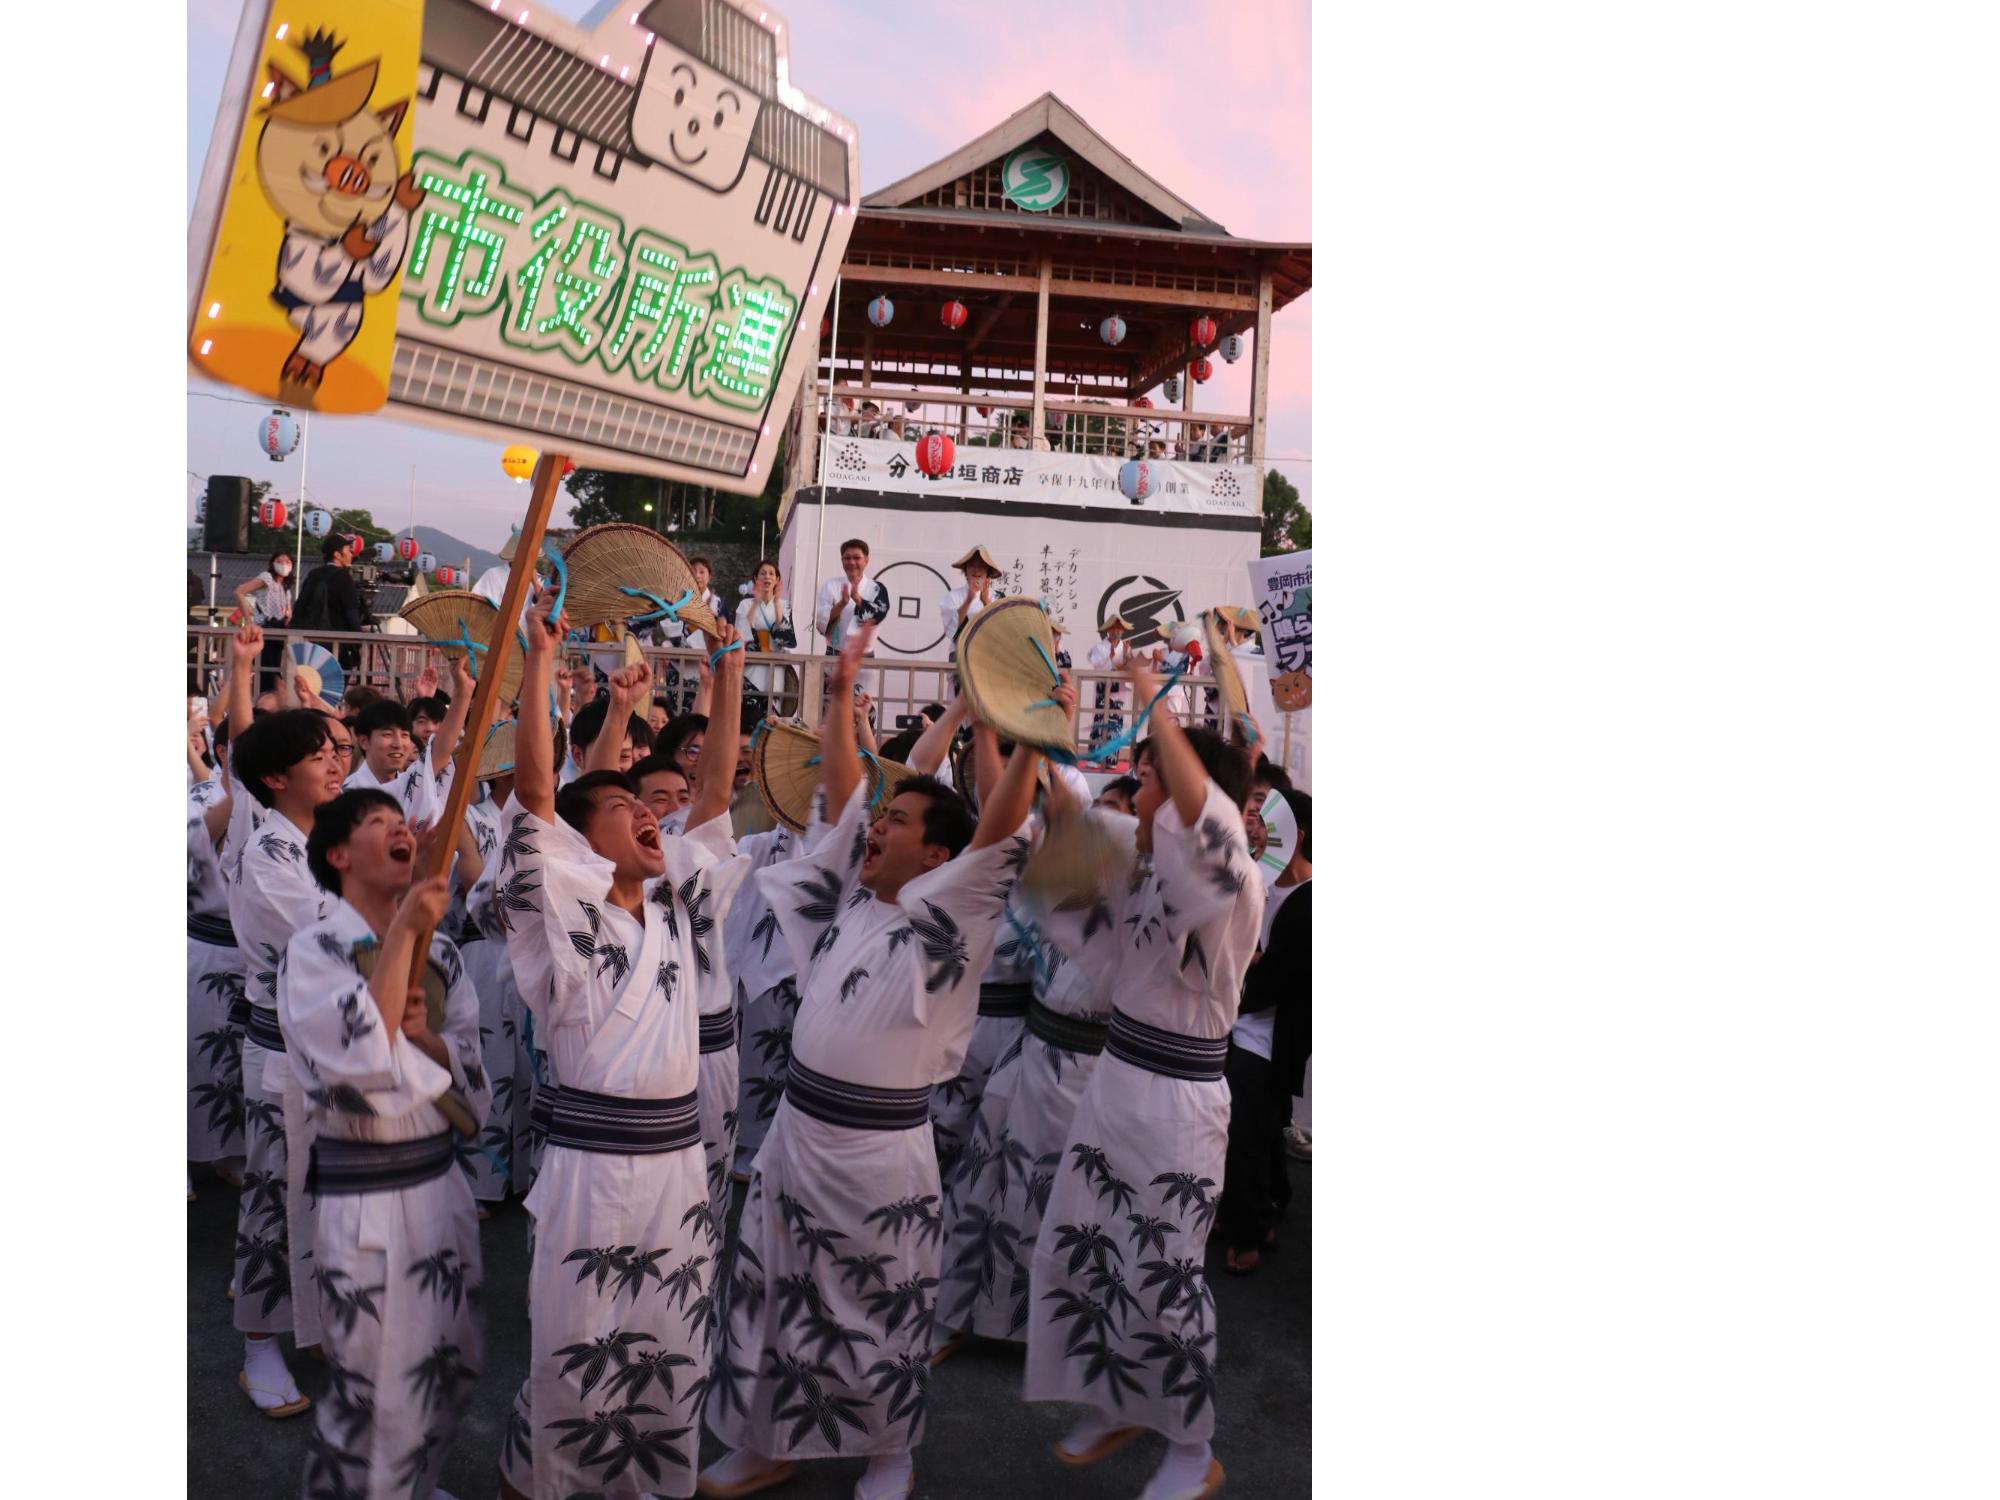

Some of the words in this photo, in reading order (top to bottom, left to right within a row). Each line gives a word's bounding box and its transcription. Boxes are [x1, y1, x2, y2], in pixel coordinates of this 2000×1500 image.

[405, 172, 796, 399] 市役所連
[829, 472, 870, 483] ODAGAKI
[914, 464, 1024, 486] 垣商店
[1205, 499, 1246, 508] ODAGAKI
[1054, 561, 1066, 624] デカンショ
[1068, 548, 1081, 610] デカンショ
